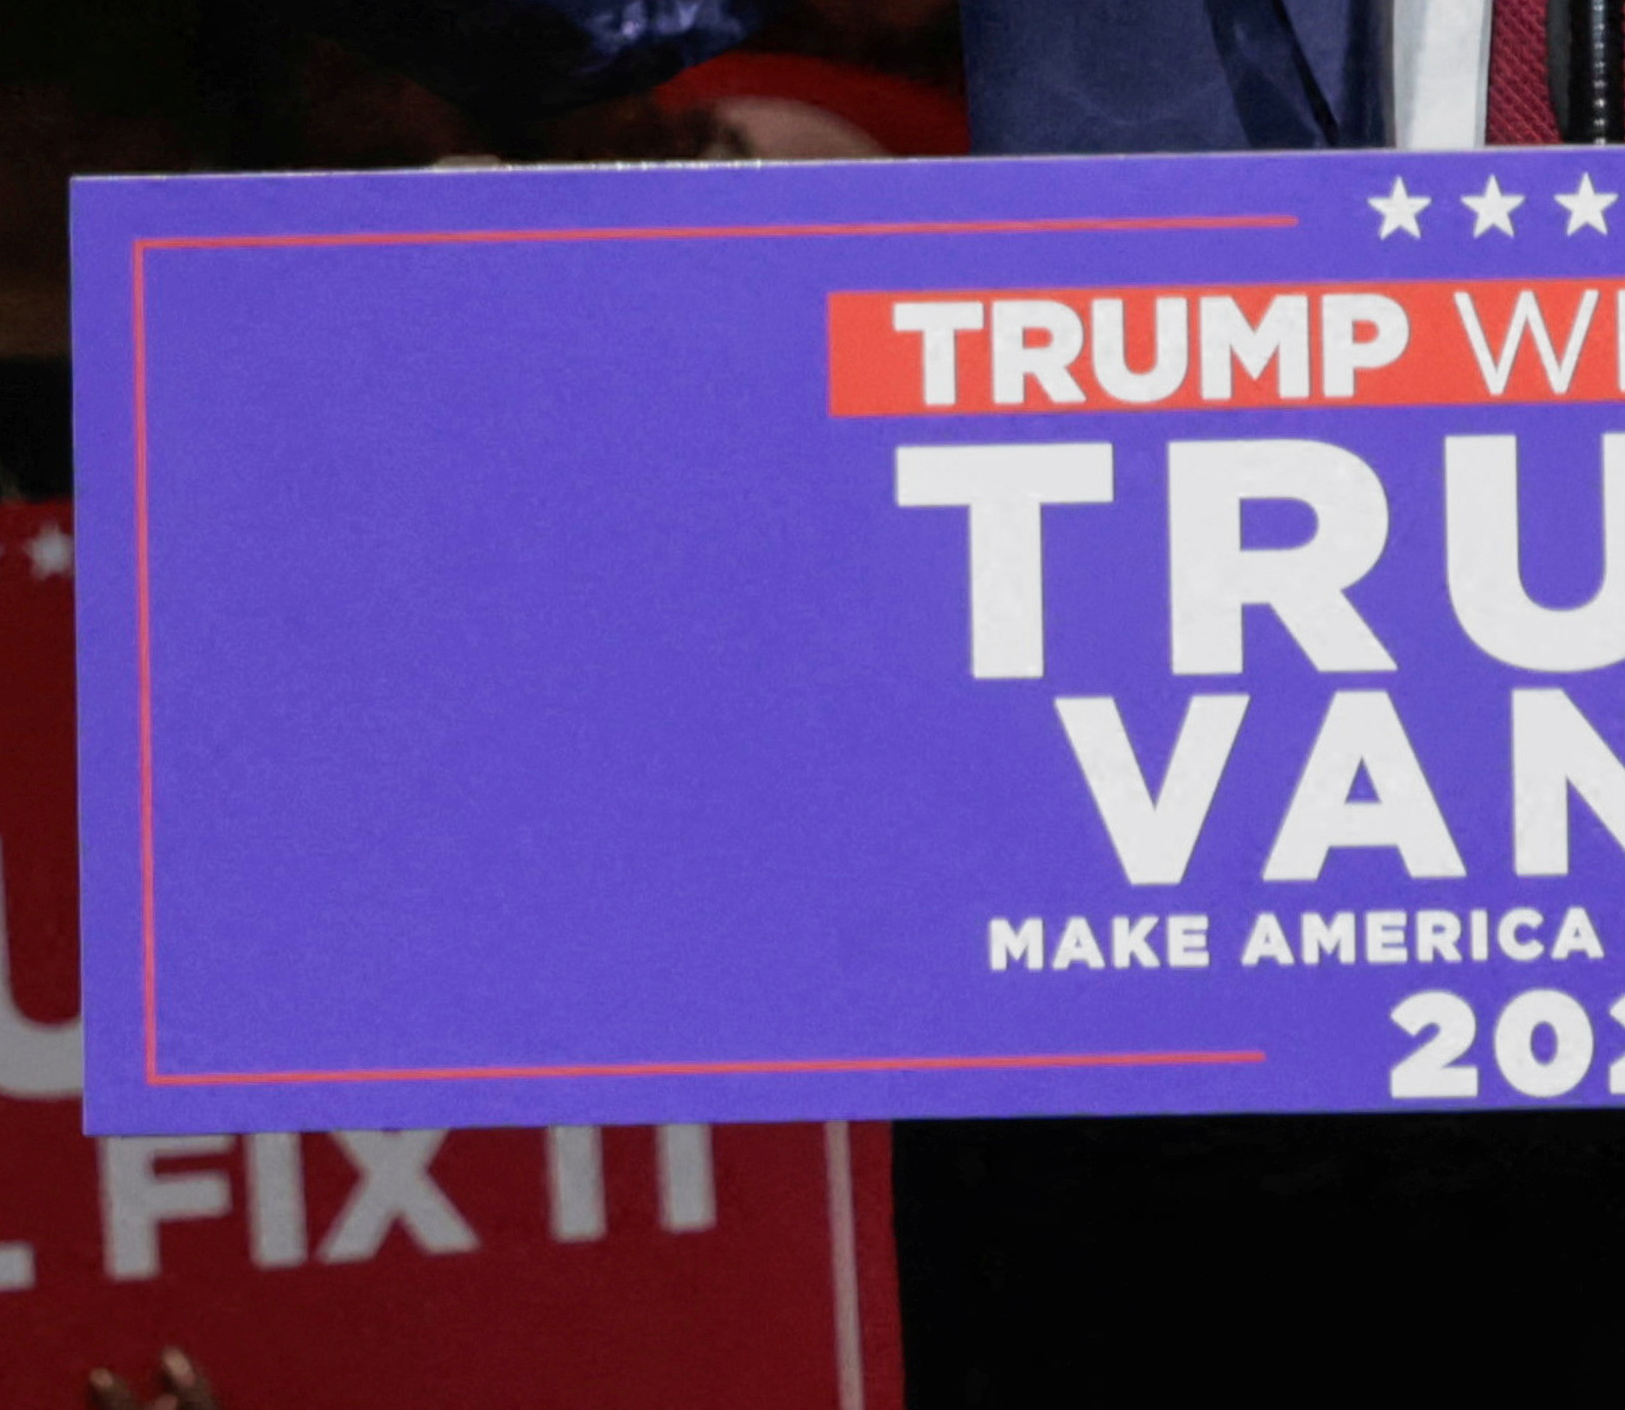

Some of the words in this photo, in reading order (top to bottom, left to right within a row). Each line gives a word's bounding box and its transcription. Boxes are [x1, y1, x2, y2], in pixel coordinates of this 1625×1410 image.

[893, 293, 1410, 407] TRUMP
[988, 914, 1210, 971] MAKE
[1241, 906, 1604, 966] AMERICA
